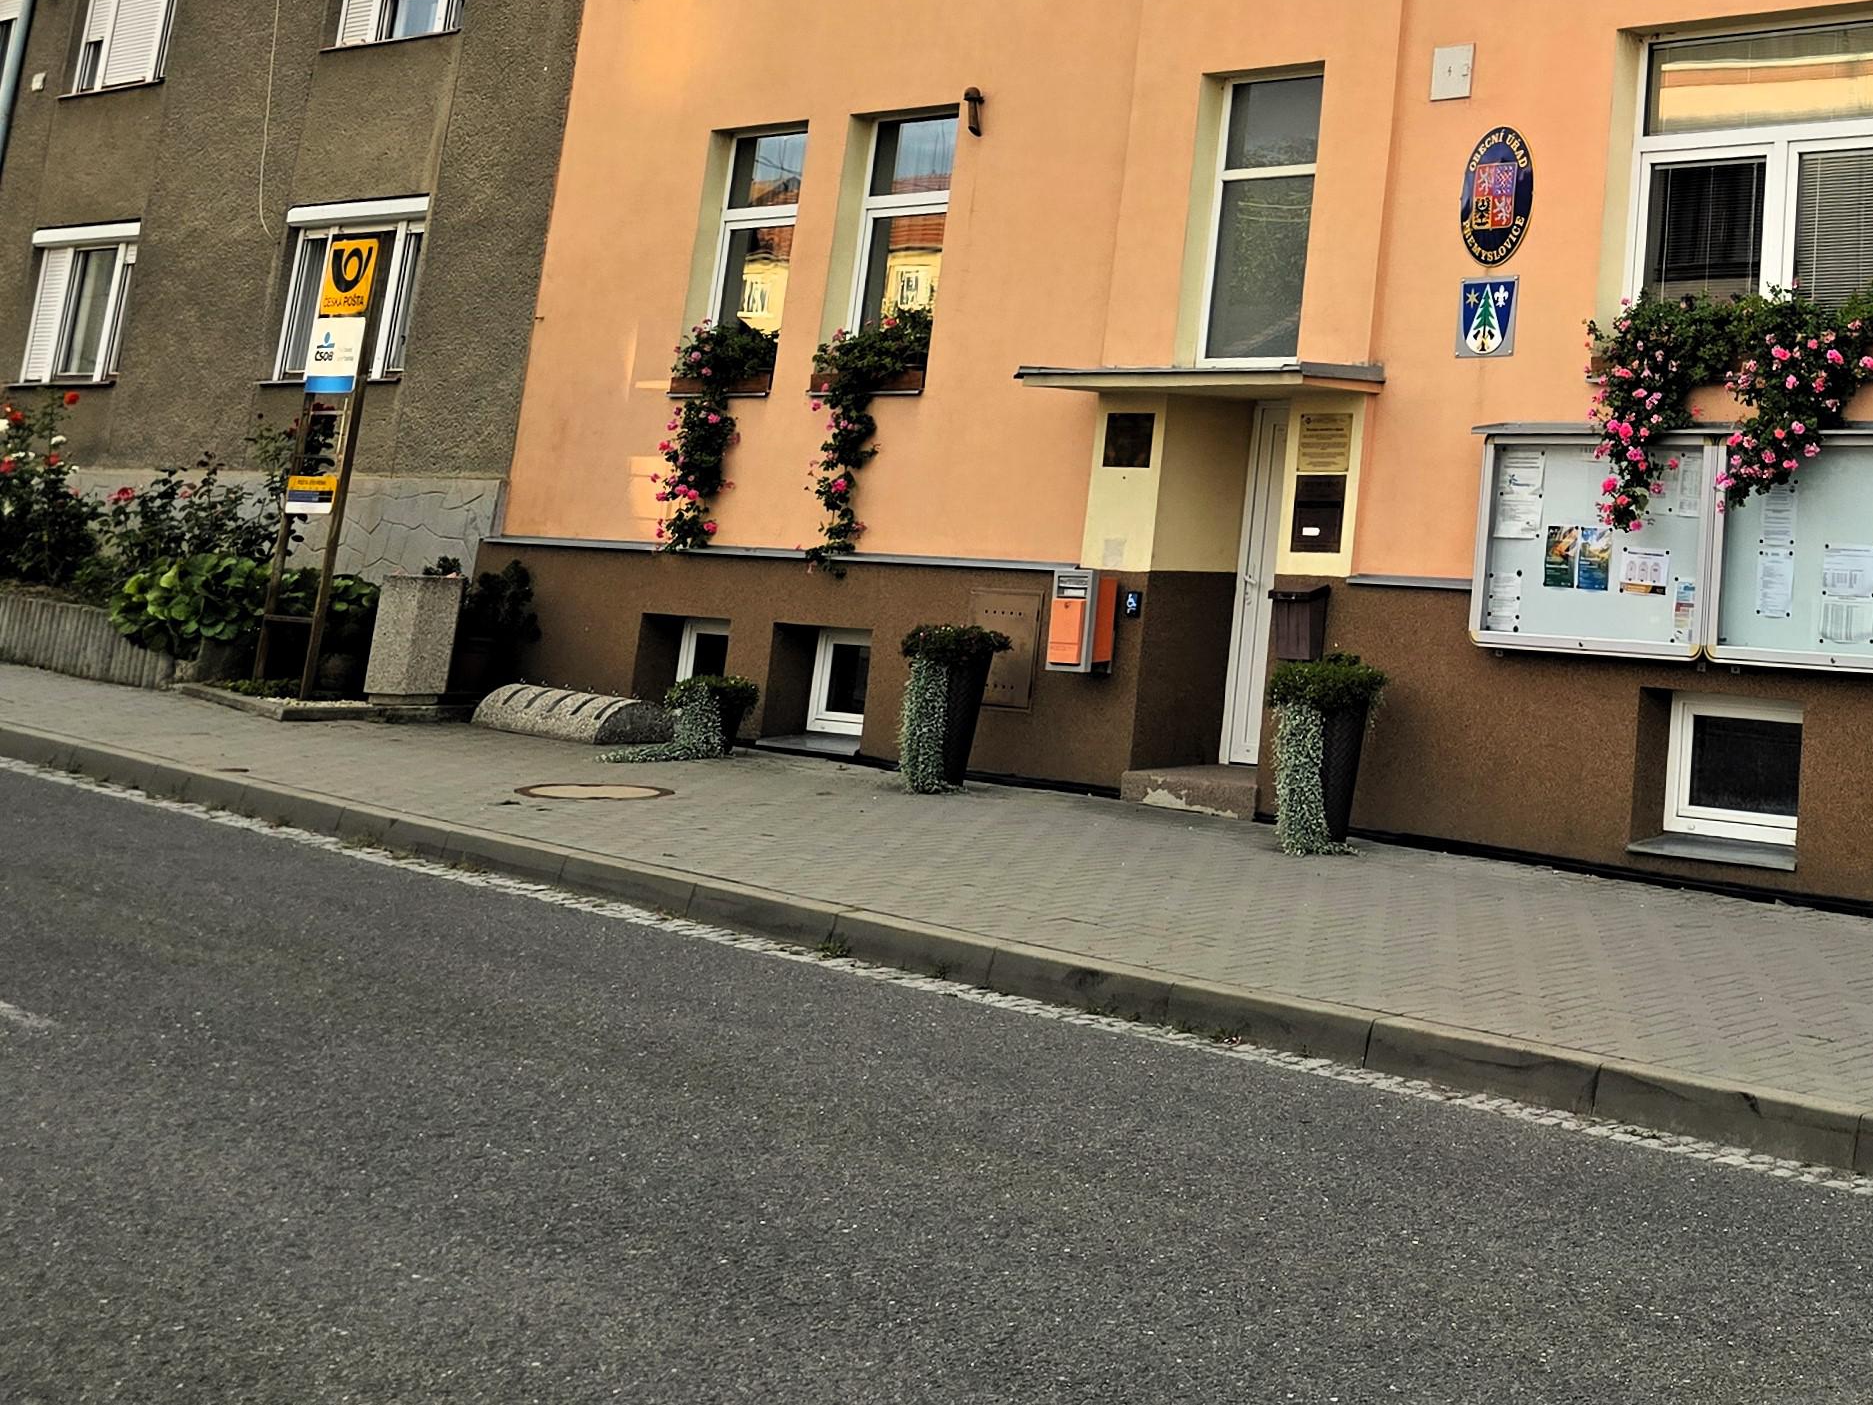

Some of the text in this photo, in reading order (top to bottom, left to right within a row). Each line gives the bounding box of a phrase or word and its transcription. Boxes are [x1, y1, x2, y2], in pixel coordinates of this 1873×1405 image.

[1469, 129, 1528, 172] OBECNÍ ÚŘAD
[1462, 215, 1525, 262] PŘEMYSLOVICE
